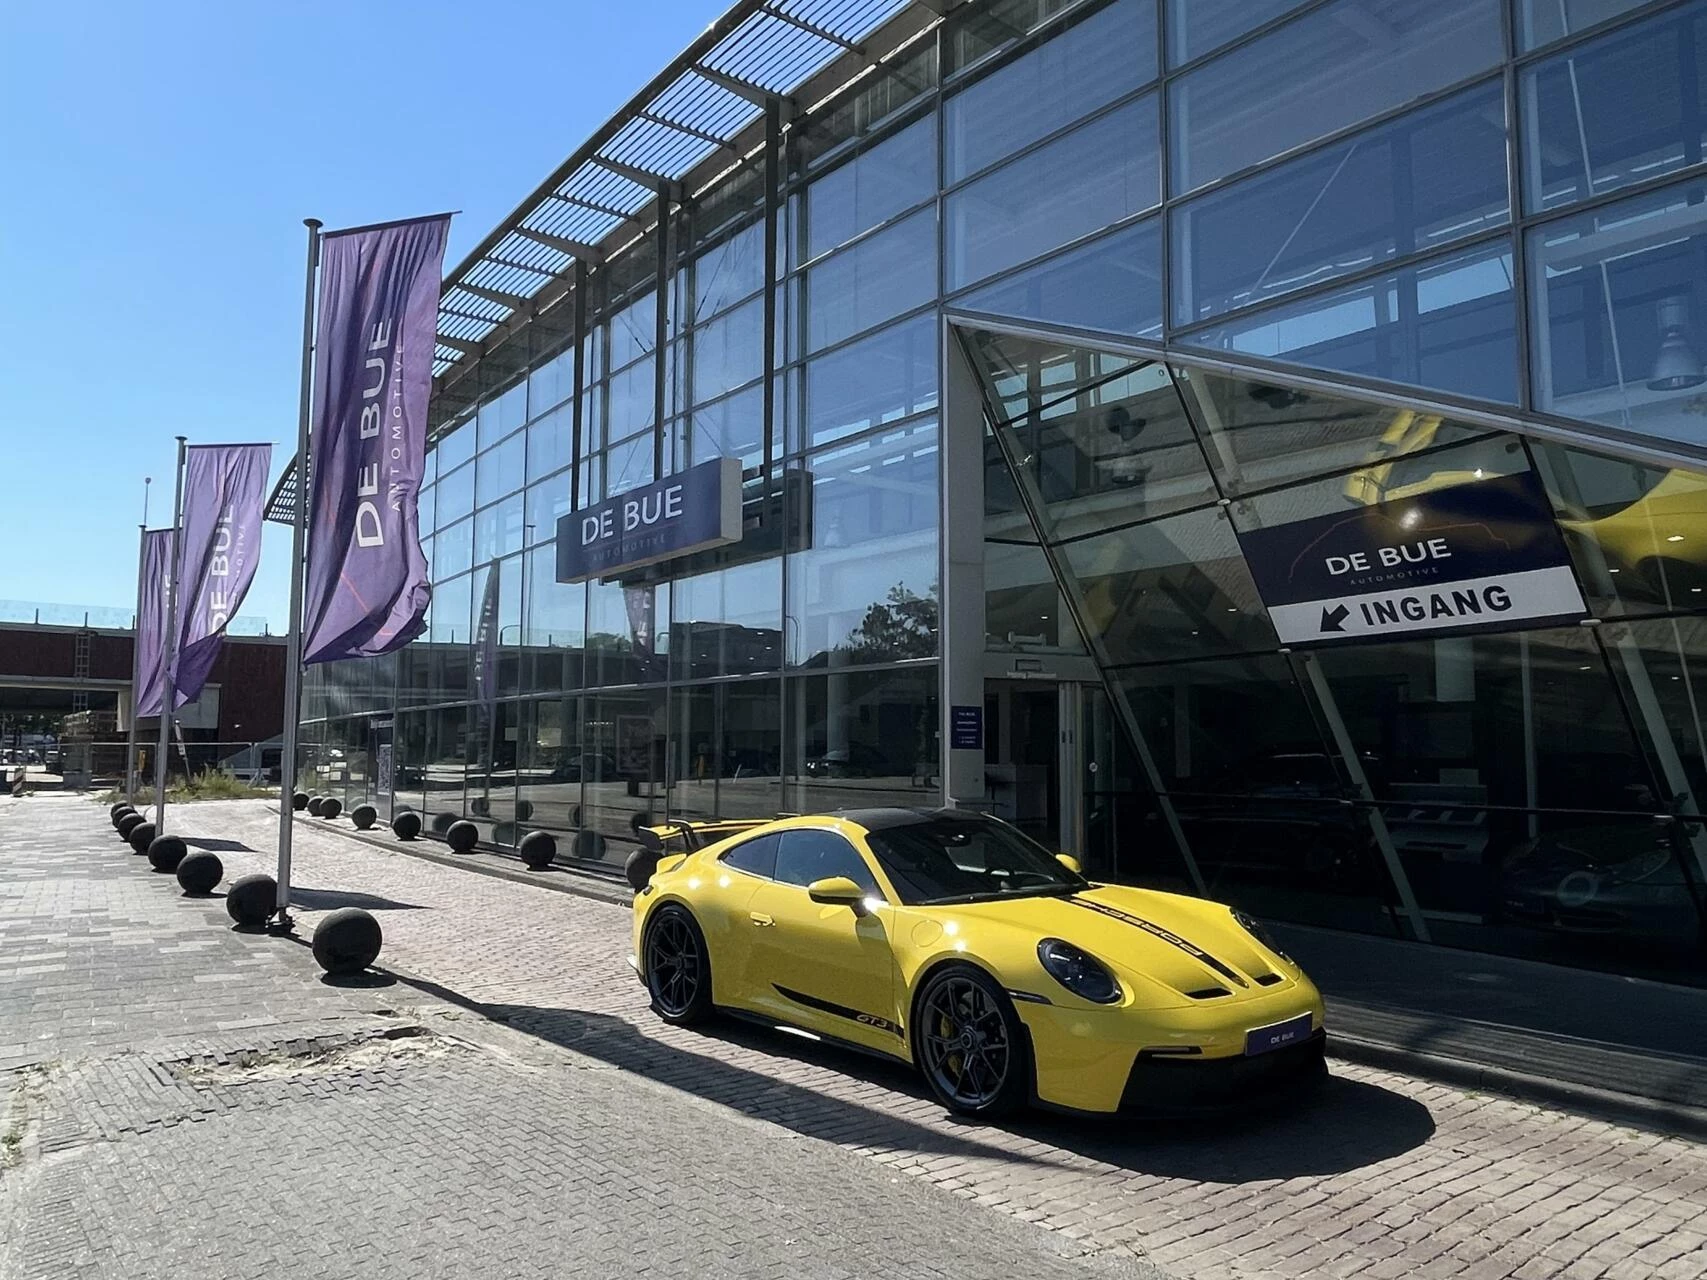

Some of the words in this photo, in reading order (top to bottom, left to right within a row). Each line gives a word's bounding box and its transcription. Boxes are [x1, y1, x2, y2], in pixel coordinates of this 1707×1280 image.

[360, 318, 392, 440] BUE
[355, 463, 384, 548] DE
[581, 508, 614, 546] DE
[624, 484, 683, 532] BUE
[1325, 552, 1371, 576] DE
[1378, 538, 1452, 568] BUE
[1349, 566, 1440, 586] AUTOMOTIVE
[1359, 585, 1513, 627] INGANG
[856, 1013, 888, 1029] GT3
